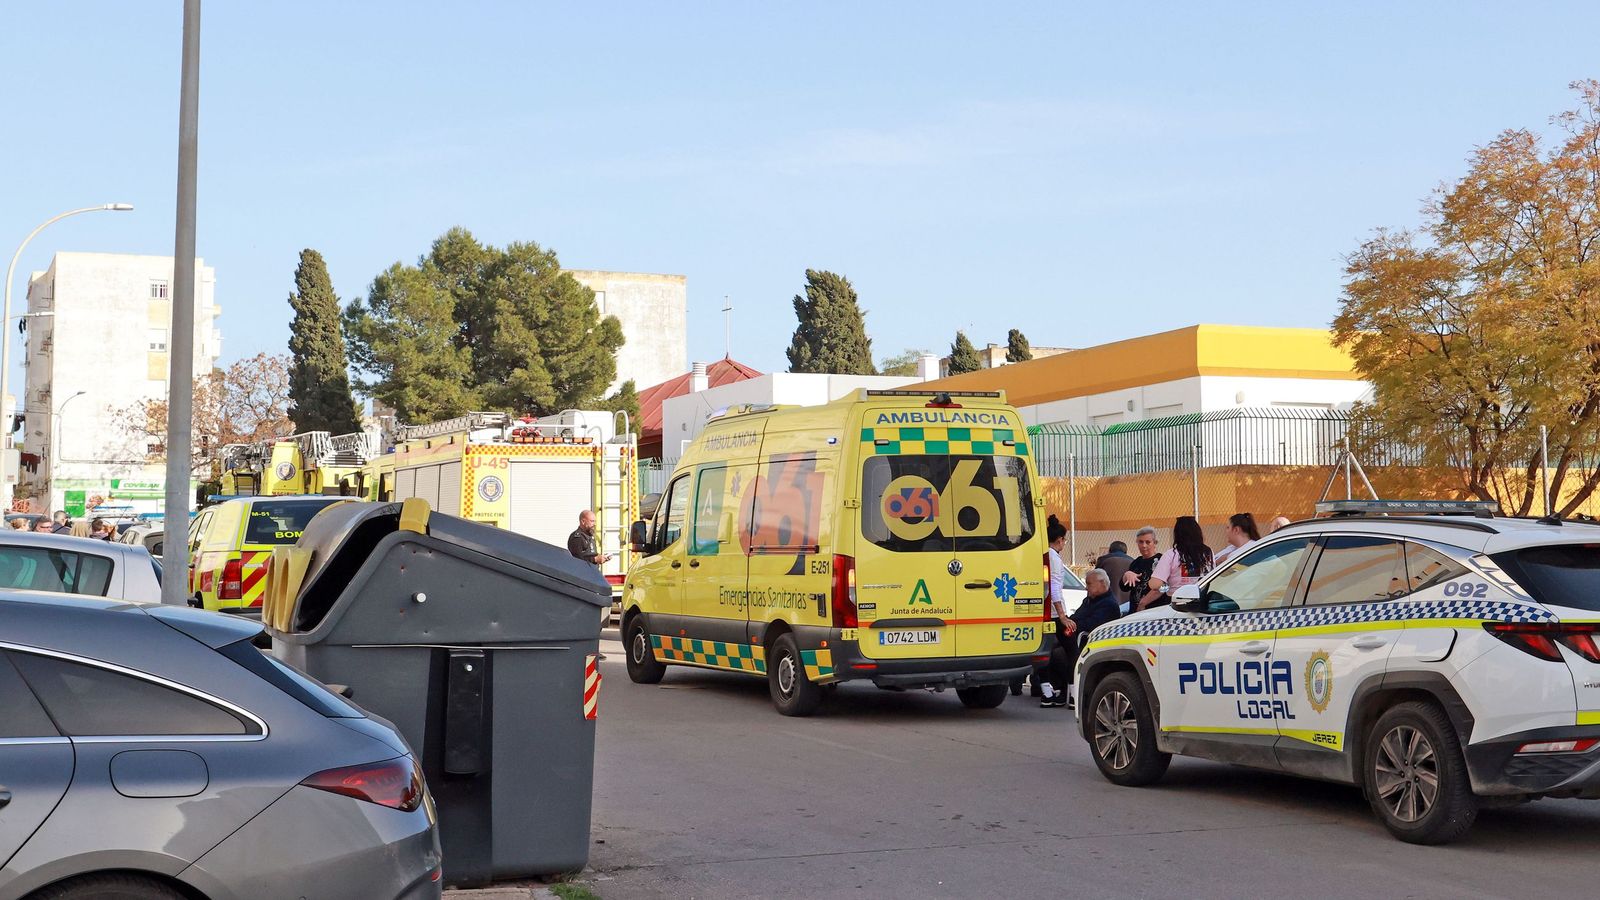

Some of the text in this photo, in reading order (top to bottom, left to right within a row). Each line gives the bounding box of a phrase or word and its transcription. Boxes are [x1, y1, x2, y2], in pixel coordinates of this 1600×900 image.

[877, 412, 1009, 426] AMBULANCIA
[704, 430, 757, 451] AMBULANCIA
[470, 456, 508, 469] U-45
[885, 488, 939, 519] 061
[811, 561, 830, 574] E-251
[1443, 581, 1489, 598] 092
[719, 585, 807, 612] Emergencias Sanitarias
[920, 606, 953, 614] Andalucía
[887, 631, 937, 645] 0742 LDM
[1001, 627, 1035, 641] E-251
[1178, 652, 1294, 695] POLICÍA
[1237, 700, 1296, 719] LOCAL
[1312, 733, 1337, 744] JEREZ
